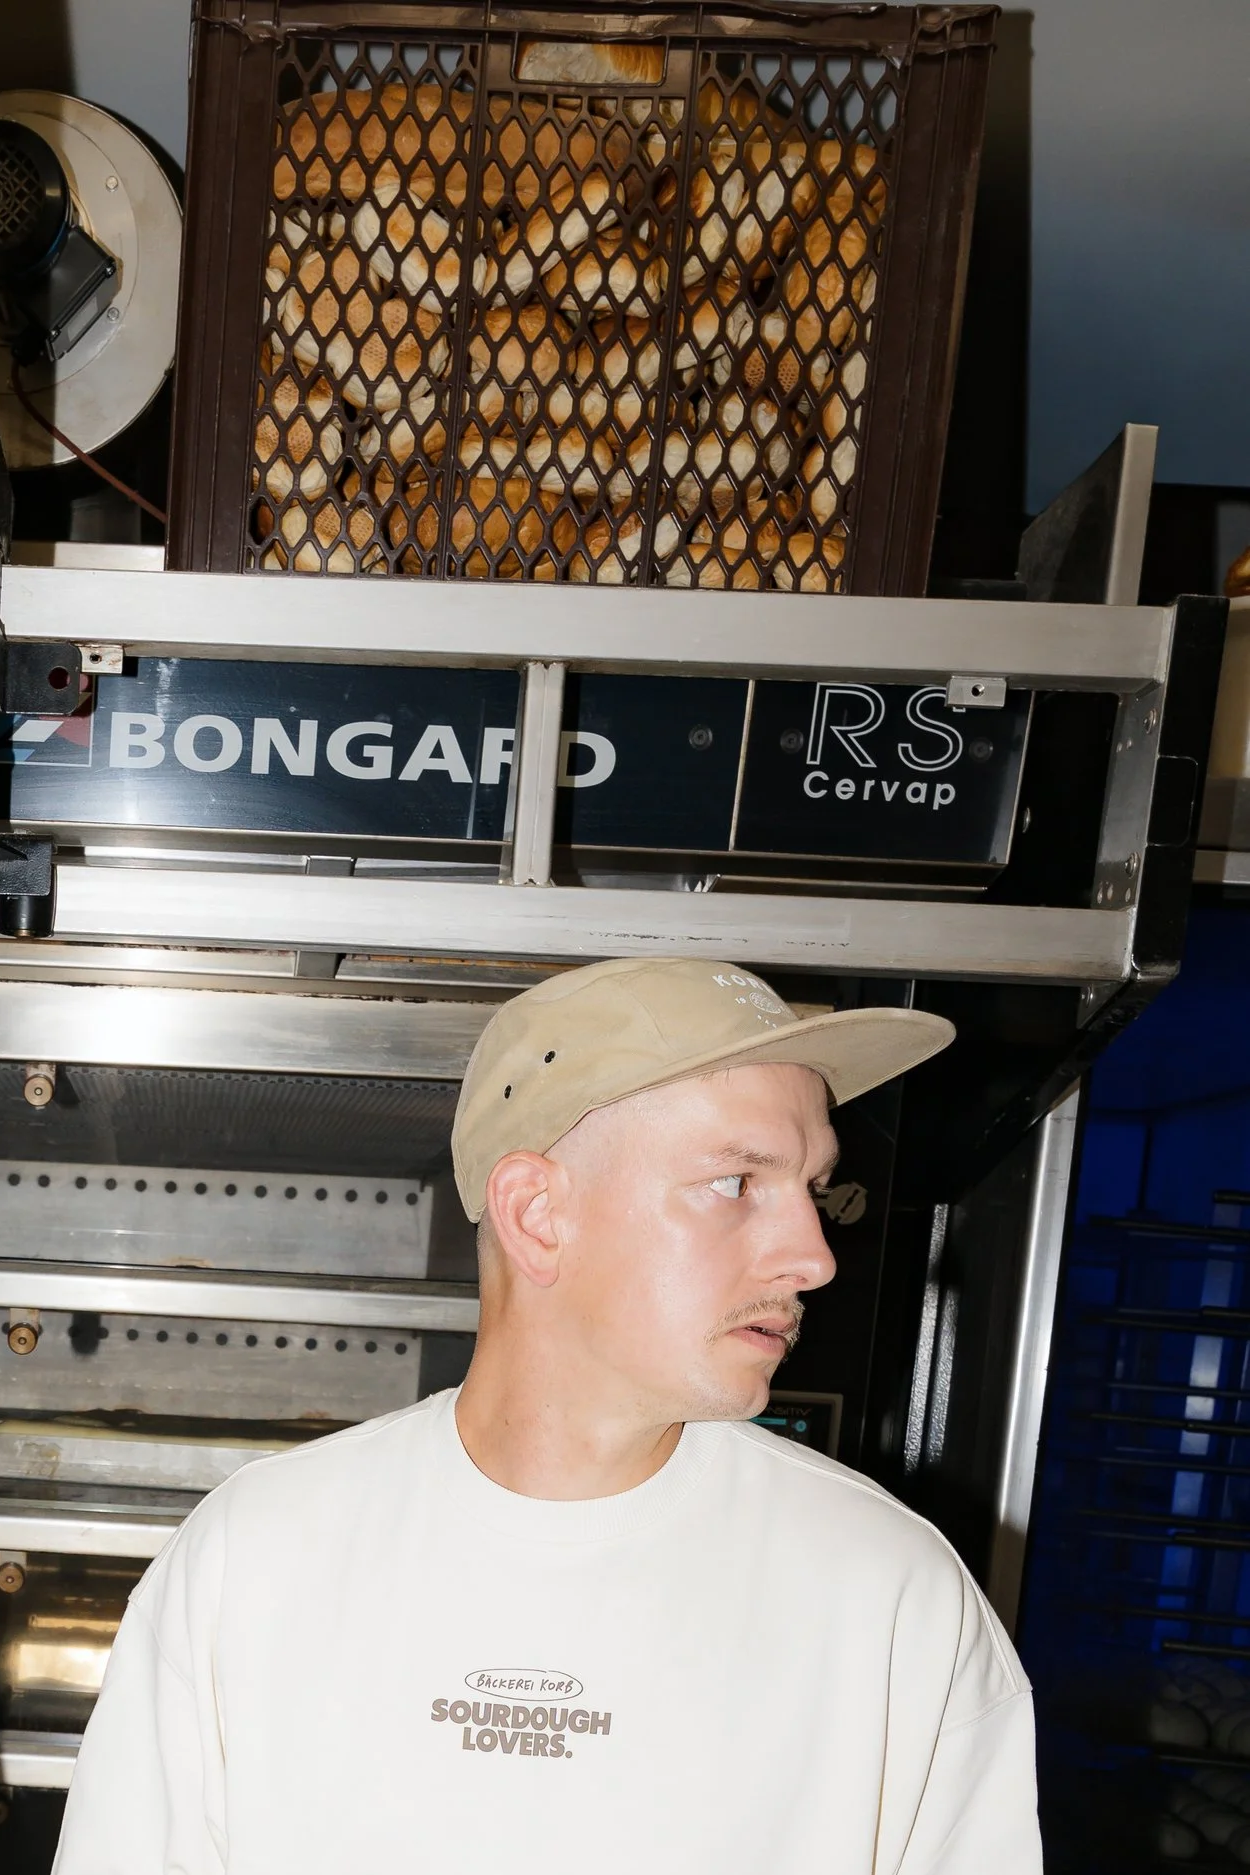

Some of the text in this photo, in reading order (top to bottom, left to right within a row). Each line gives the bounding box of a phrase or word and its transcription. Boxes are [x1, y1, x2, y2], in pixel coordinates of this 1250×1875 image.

[803, 770, 956, 811] Cervap
[712, 974, 777, 998] KOR
[476, 1673, 574, 1694] BÄCKEREI KORB
[430, 1698, 612, 1736] SOURDOUGH
[462, 1726, 573, 1759] LOVERS.
